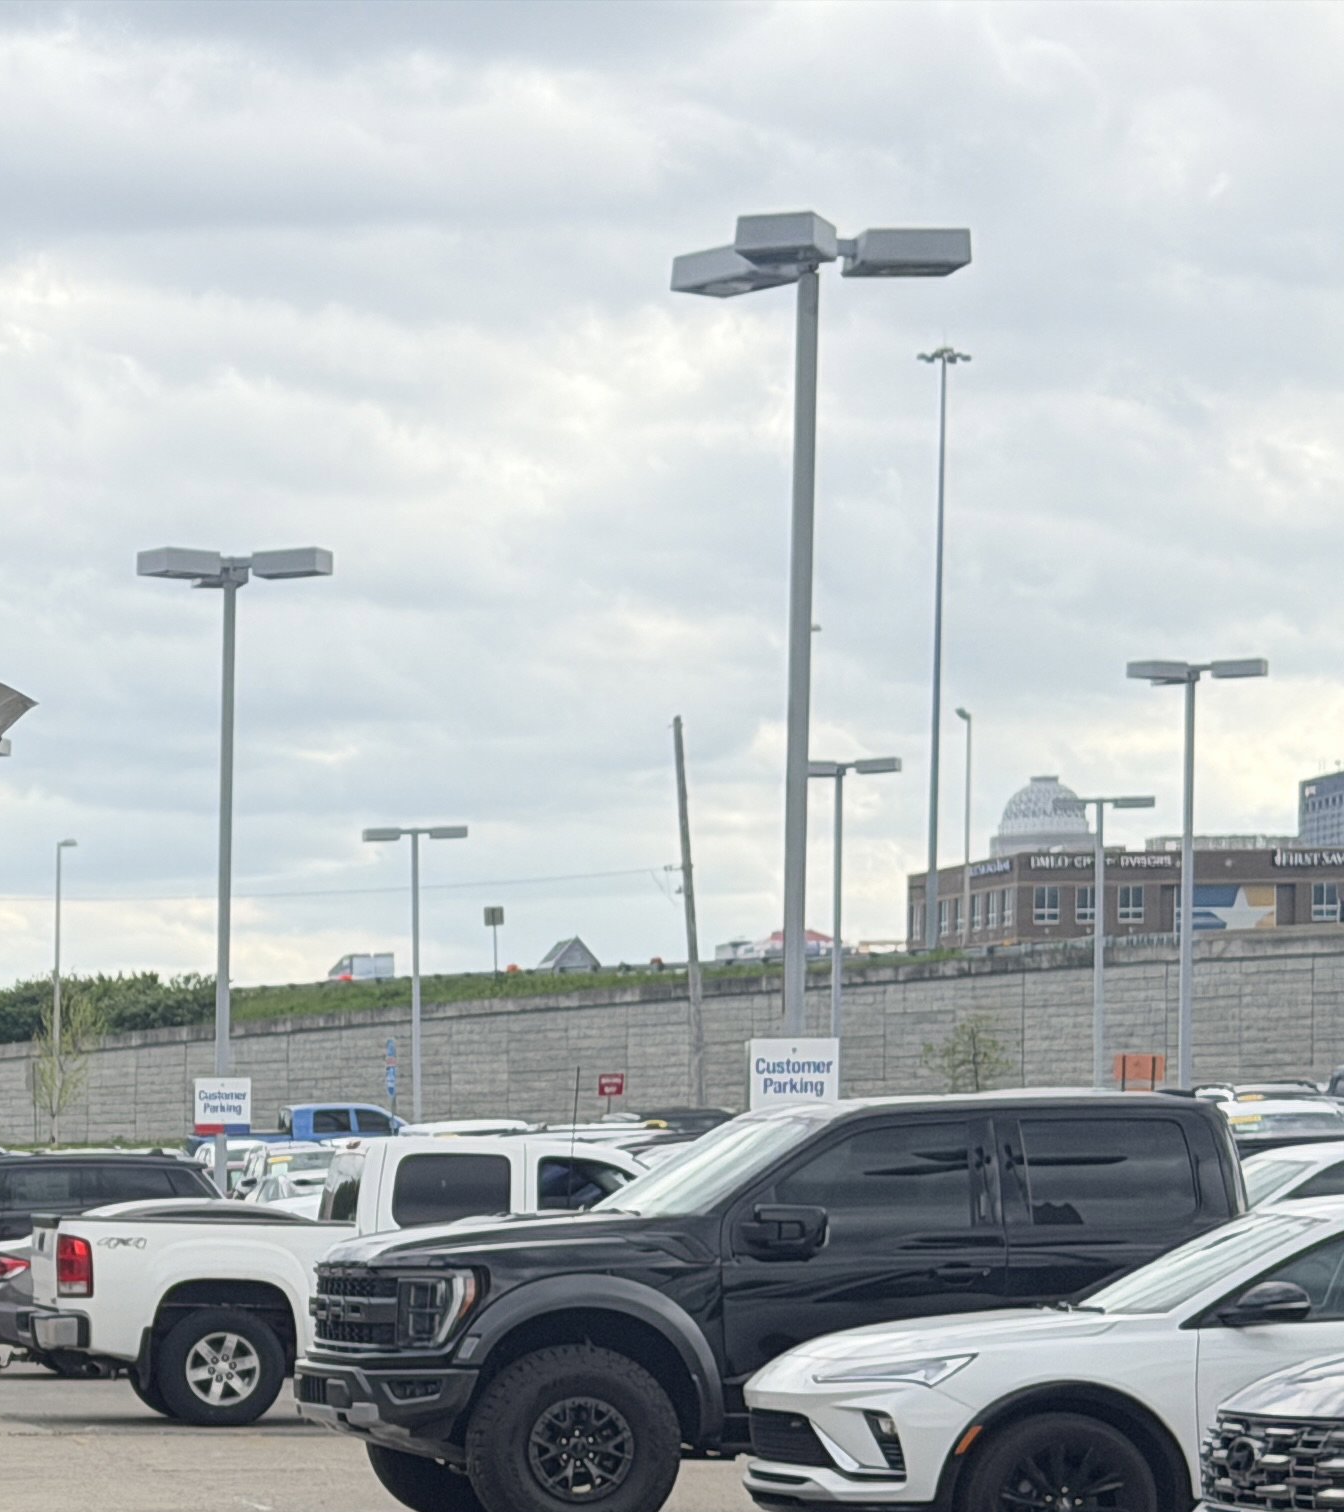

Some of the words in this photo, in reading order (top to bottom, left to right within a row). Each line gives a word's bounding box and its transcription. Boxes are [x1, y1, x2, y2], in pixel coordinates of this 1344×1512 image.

[755, 1057, 833, 1075] Customer
[763, 1077, 825, 1096] Parking
[198, 1089, 247, 1101] Customer
[203, 1102, 242, 1116] Parking
